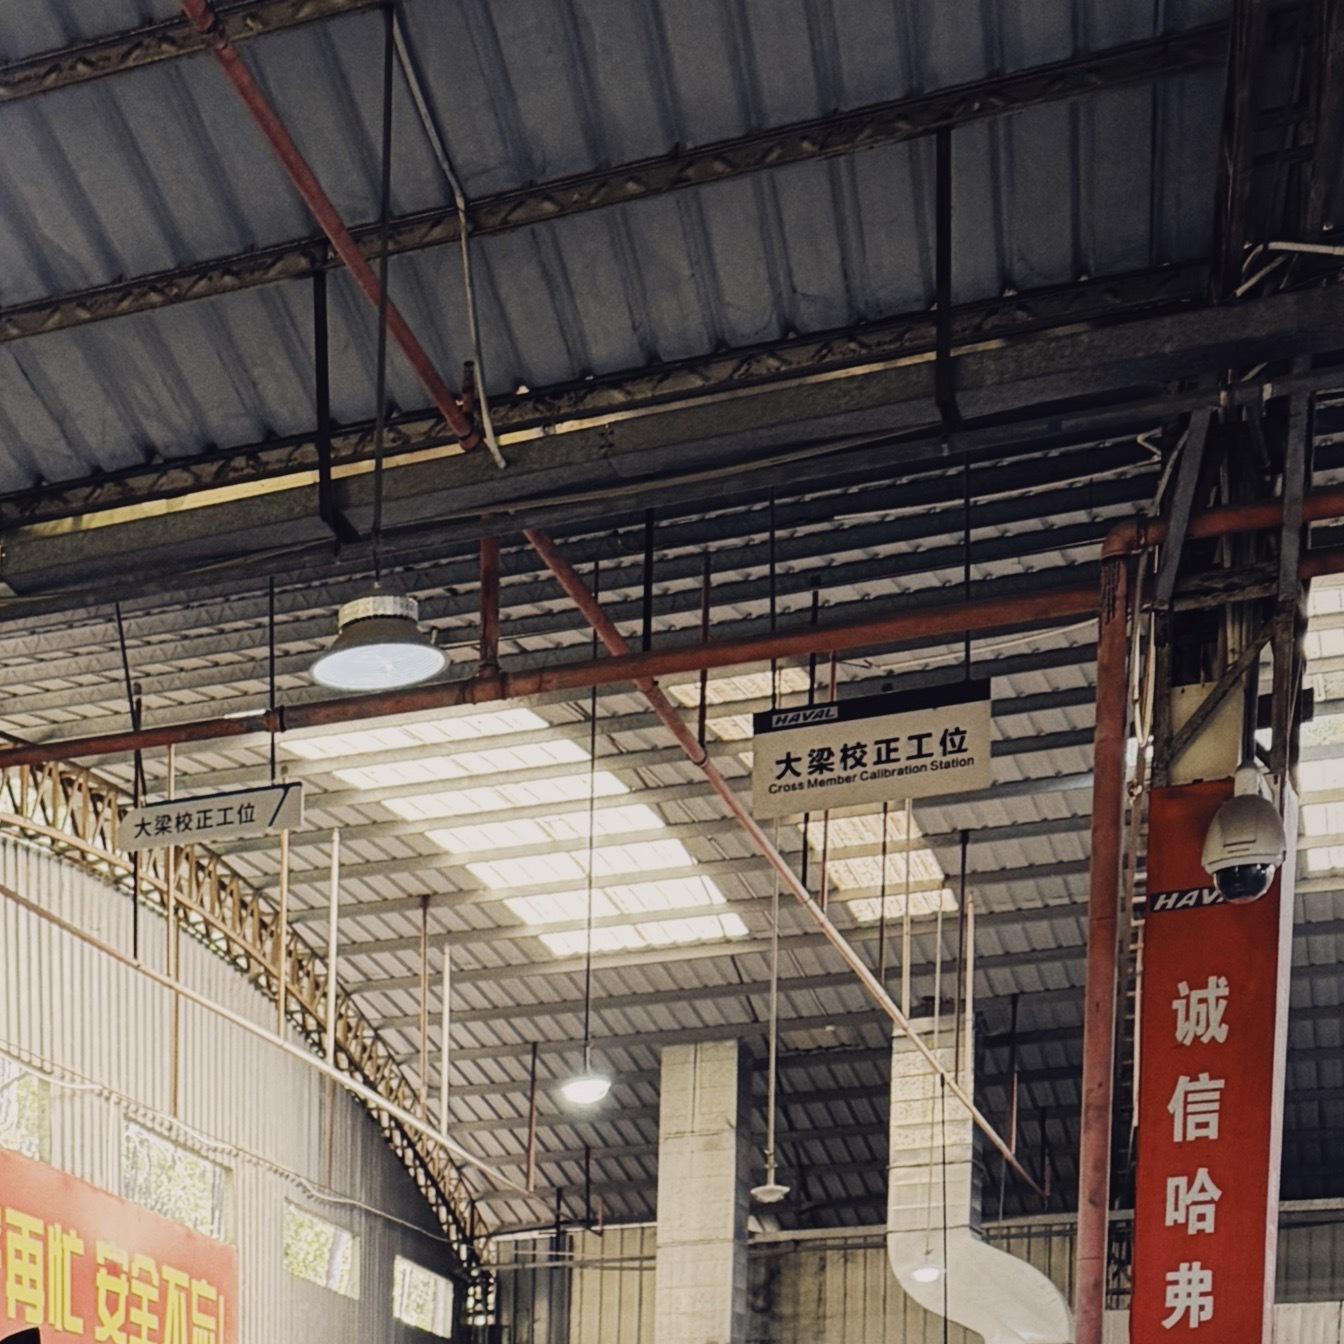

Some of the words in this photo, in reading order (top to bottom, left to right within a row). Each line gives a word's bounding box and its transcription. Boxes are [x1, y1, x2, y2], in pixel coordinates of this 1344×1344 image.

[774, 706, 836, 726] HAVAL
[775, 727, 968, 780] 大梁校正工位
[768, 781, 805, 795] Cross
[807, 773, 857, 789] Member
[859, 763, 928, 782] Calibration
[929, 755, 975, 772] Station
[134, 803, 256, 839] 大梁校正工位
[1154, 888, 1224, 910] HAV
[1161, 976, 1230, 1329] 诚信哈弗
